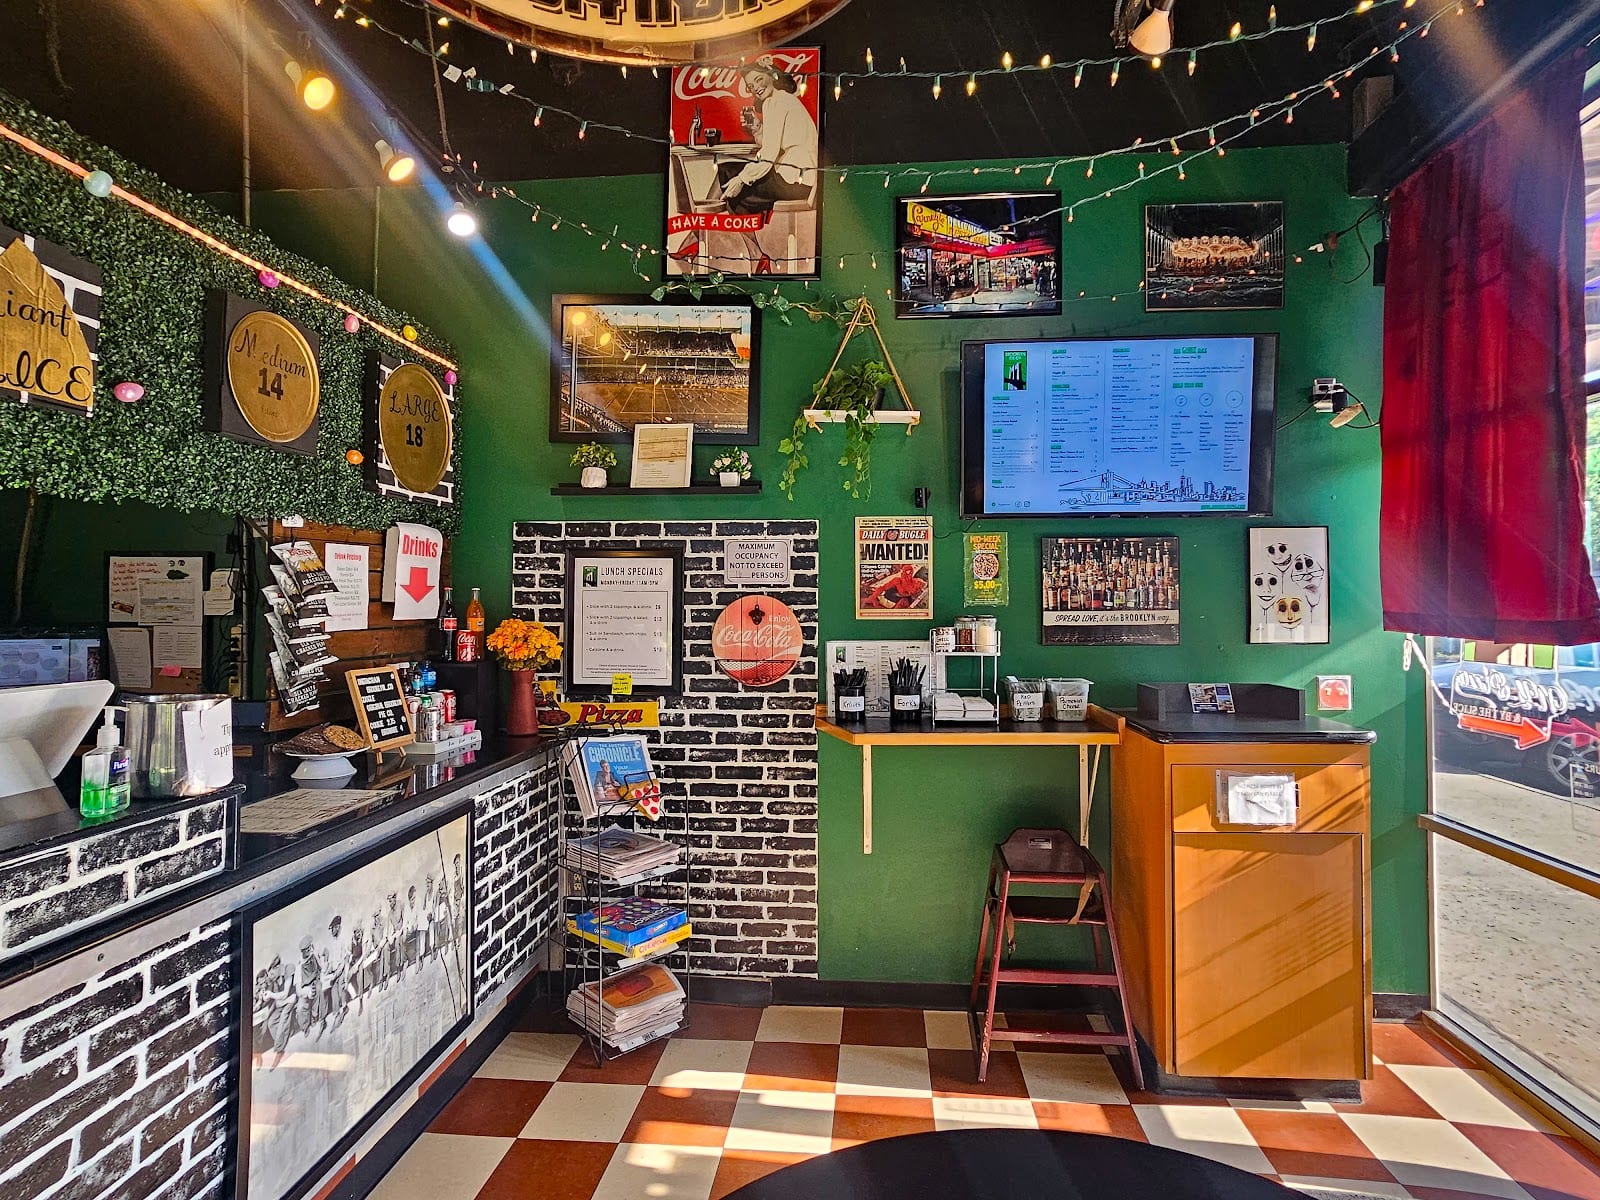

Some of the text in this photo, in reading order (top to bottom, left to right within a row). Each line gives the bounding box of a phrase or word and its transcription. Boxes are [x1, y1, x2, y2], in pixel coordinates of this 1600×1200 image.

[672, 216, 759, 230] HAVE A COKE
[0, 290, 71, 337] iant
[389, 390, 441, 424] LARGE
[862, 530, 926, 539] DAILY BUGLE
[402, 534, 439, 559] Drinks
[860, 543, 928, 560] WANTED!
[601, 567, 663, 576] LUNCH SPECIALS
[974, 580, 995, 589] $5.00
[1055, 614, 1080, 623] SPREAD
[1120, 613, 1156, 622] BROOKLYN
[576, 703, 644, 725] Pizza
[588, 746, 641, 763] CHRONICLE
